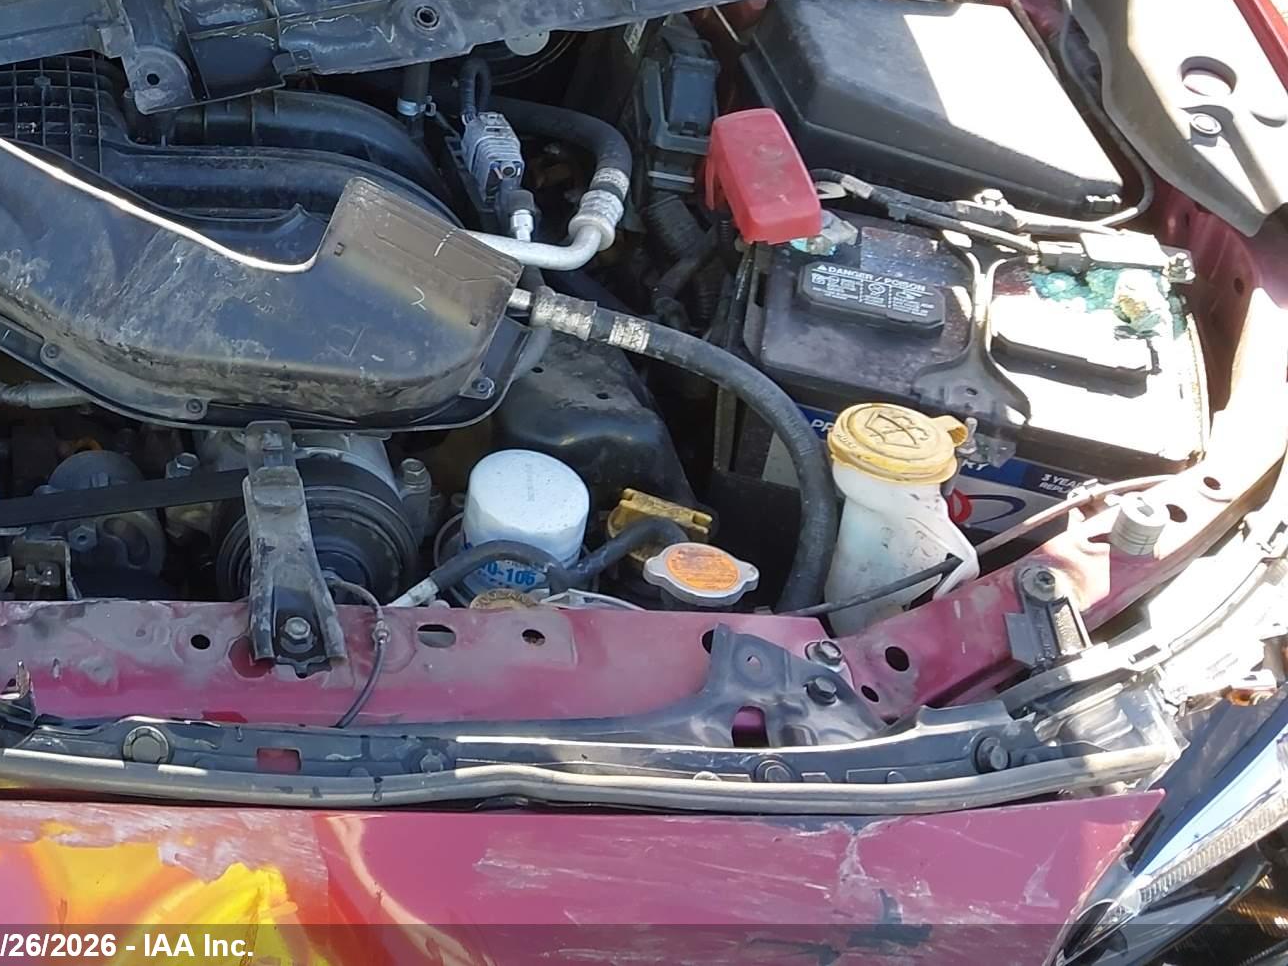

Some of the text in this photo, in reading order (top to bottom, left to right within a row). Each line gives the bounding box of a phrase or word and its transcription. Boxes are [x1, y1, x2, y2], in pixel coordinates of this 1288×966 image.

[827, 265, 874, 281] DANGER
[884, 277, 926, 292] POISON
[1041, 473, 1052, 482] 3
